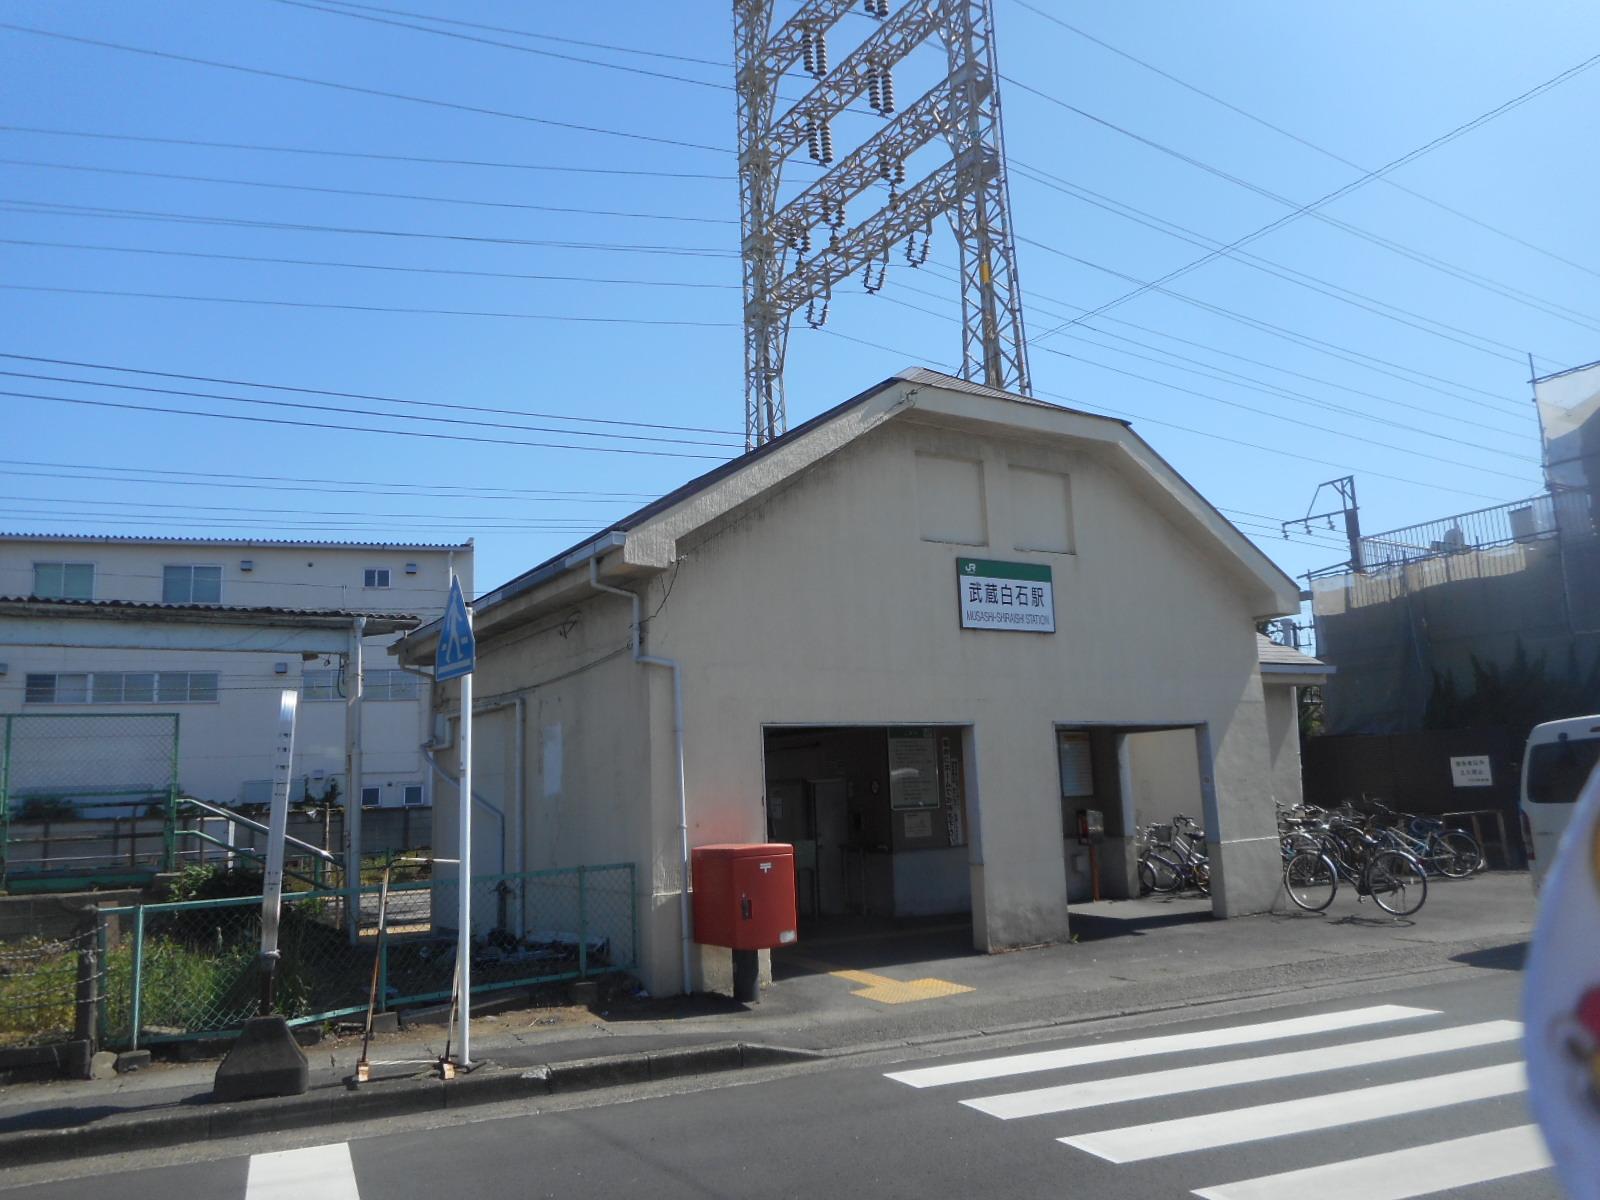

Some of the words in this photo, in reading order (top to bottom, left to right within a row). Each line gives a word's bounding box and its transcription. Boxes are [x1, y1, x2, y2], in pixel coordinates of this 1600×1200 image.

[969, 582, 1044, 607] 武蔵白石駅
[1025, 614, 1050, 625] STATION
